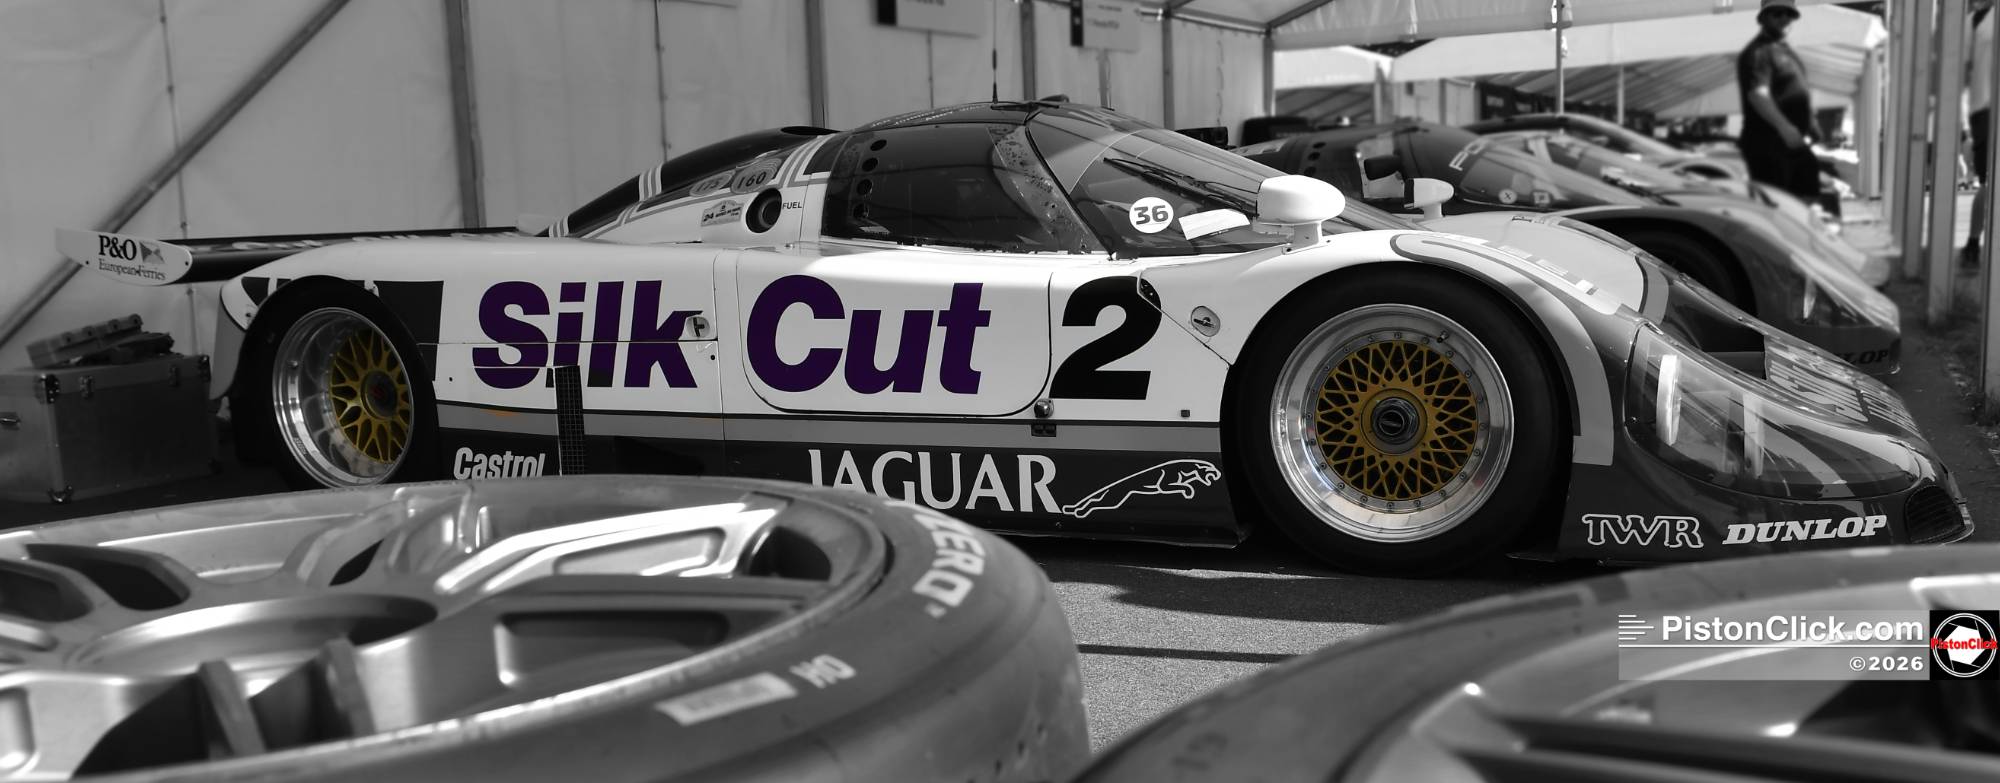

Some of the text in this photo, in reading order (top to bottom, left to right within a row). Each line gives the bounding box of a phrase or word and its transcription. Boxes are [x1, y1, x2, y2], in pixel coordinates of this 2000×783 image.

[696, 177, 723, 193] 175
[737, 171, 767, 189] 160
[782, 201, 802, 209] FUEL
[1134, 205, 1169, 226] 36
[98, 235, 137, 261] P&O
[472, 274, 991, 395] Silk Cut
[1049, 275, 1162, 400] 2
[453, 447, 546, 480] Castrol
[1581, 513, 1887, 549] TWR DUNLOP
